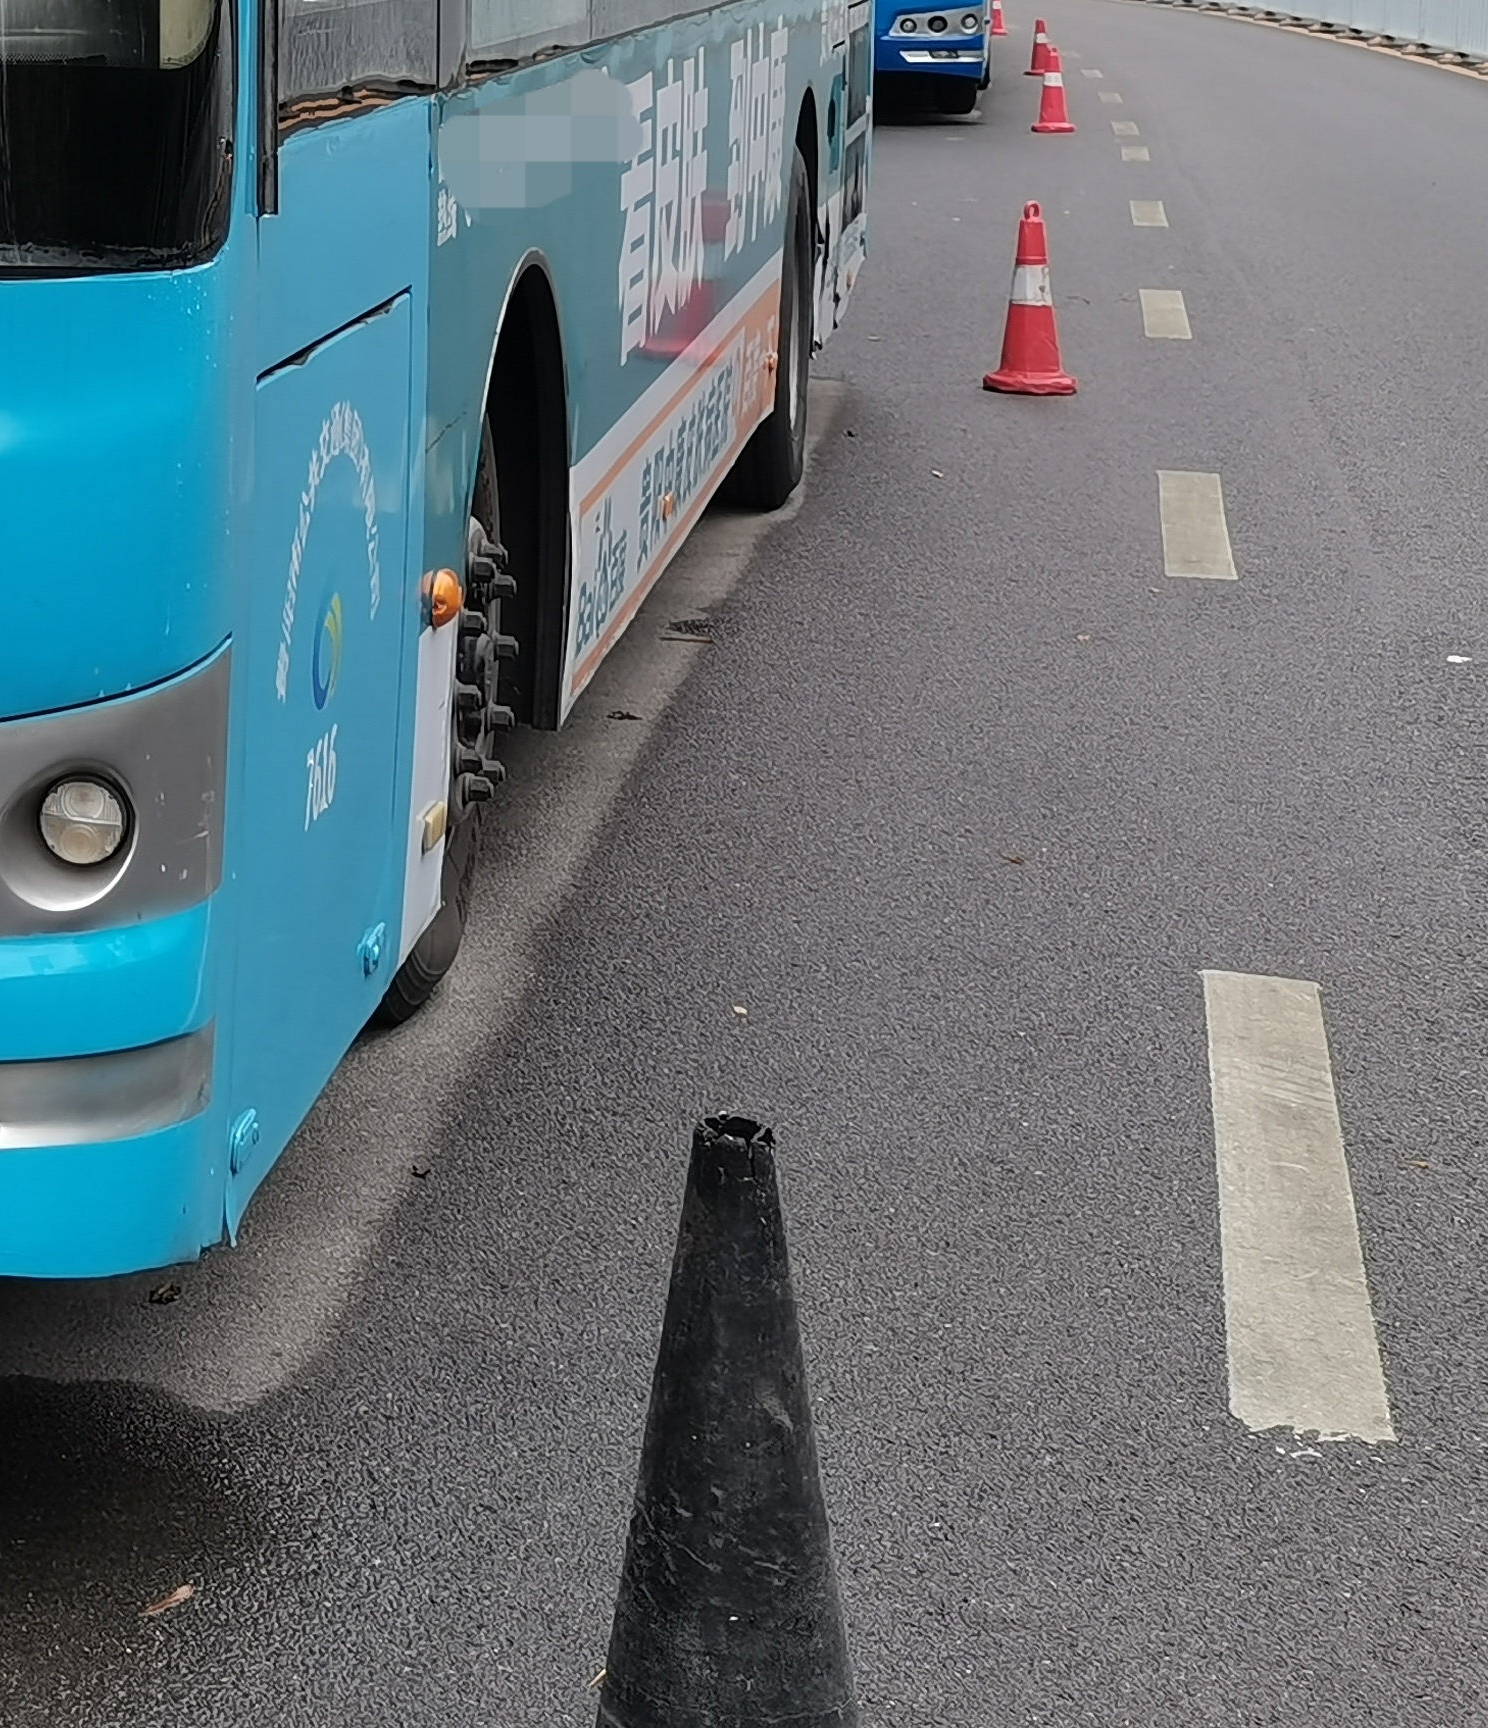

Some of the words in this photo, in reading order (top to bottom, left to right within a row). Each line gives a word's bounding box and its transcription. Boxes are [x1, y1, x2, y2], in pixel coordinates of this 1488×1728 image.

[618, 46, 709, 368] 看皮肤
[303, 722, 339, 833] 7616
